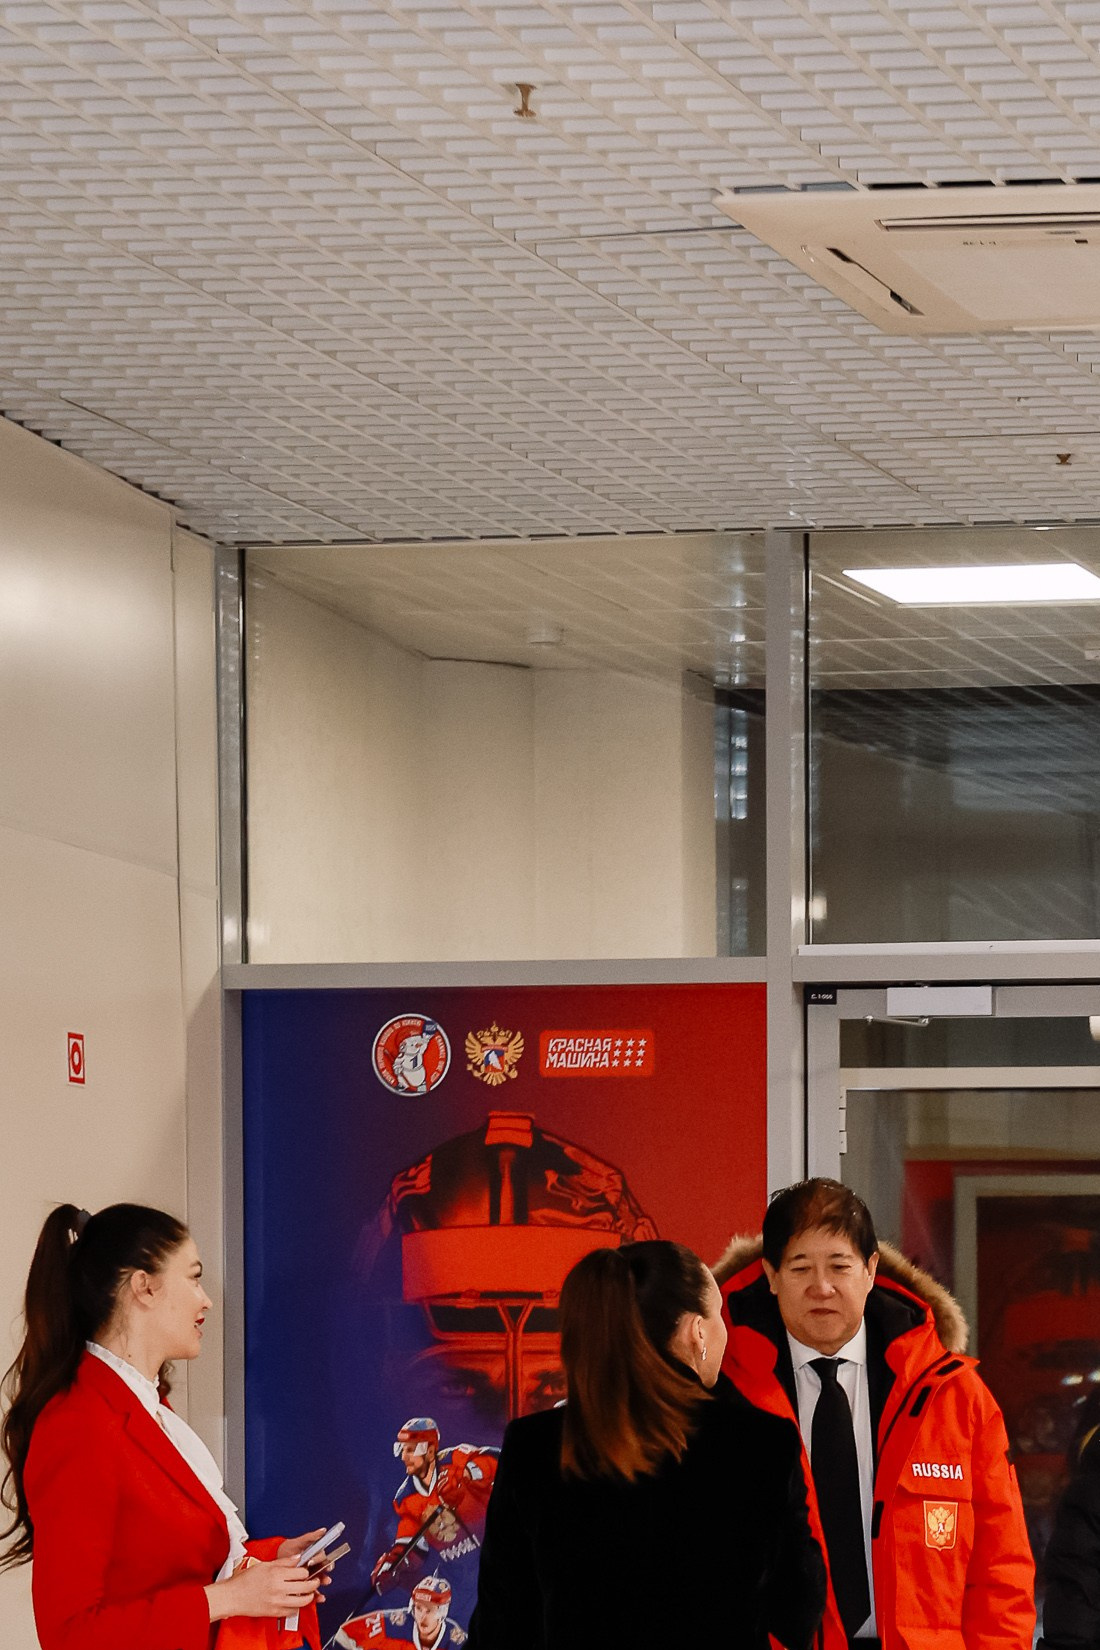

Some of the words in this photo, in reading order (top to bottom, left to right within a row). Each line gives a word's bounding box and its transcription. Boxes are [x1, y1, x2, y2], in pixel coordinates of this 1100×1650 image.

[548, 1038, 613, 1053] КРАСНАЯ
[545, 1052, 610, 1069] МАШИНА
[911, 1462, 964, 1481] RUSSIA
[365, 1613, 383, 1639] 24
